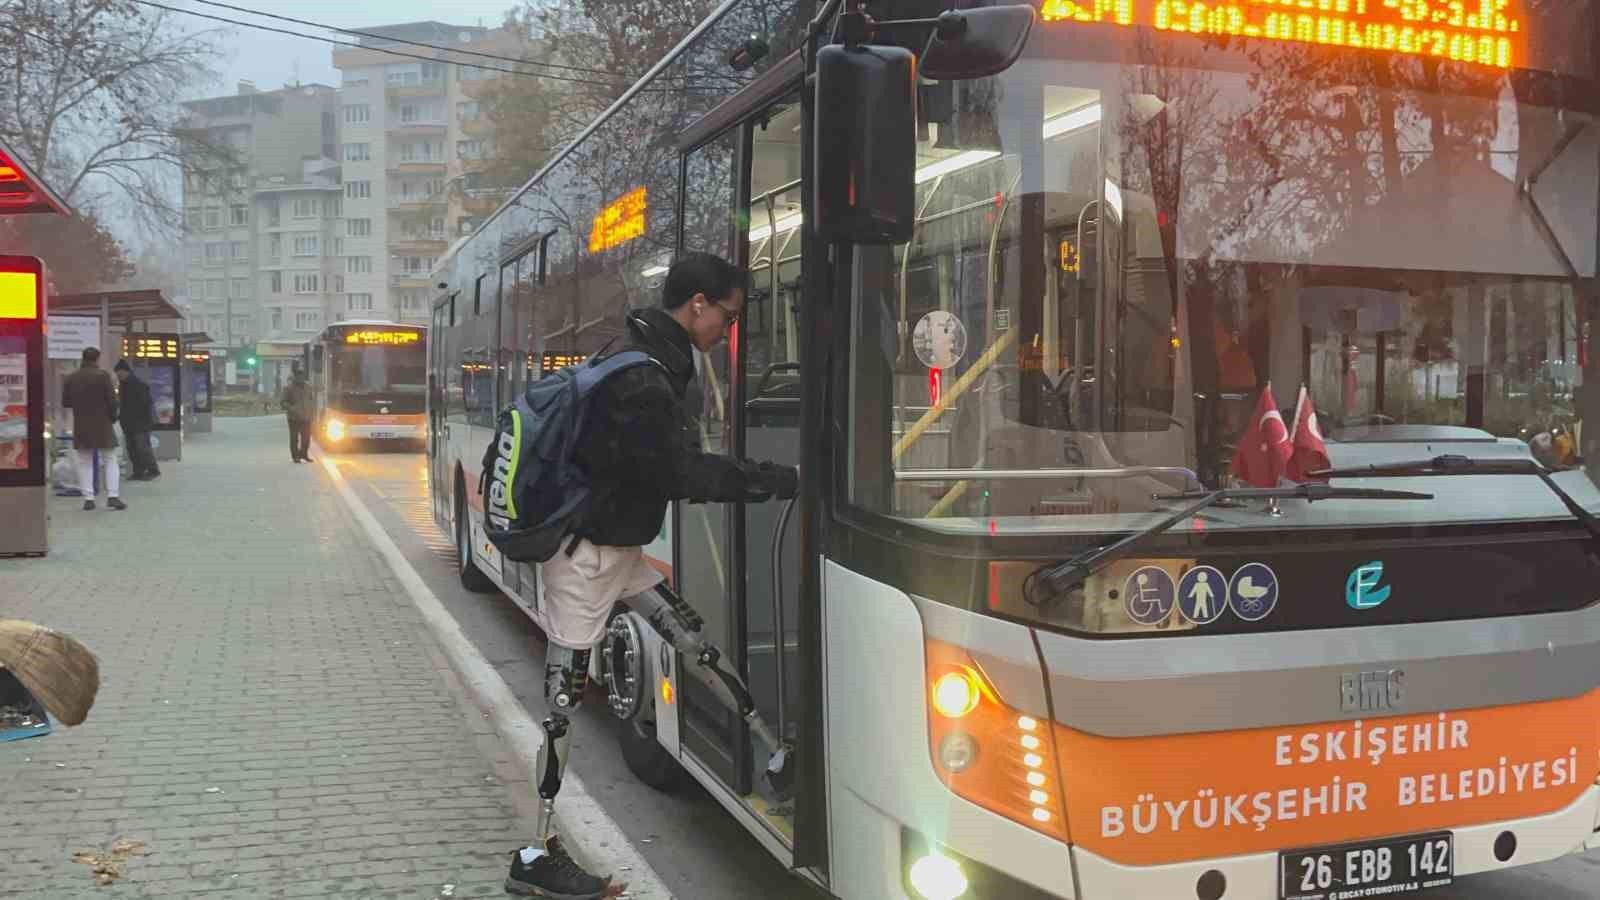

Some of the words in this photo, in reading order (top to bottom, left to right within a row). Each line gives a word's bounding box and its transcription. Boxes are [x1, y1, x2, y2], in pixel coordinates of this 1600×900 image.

[1336, 669, 1406, 712] BMC
[1276, 713, 1470, 766] ESKİŞEHİR
[1101, 775, 1368, 838] BÜYÜKŞEHİR
[1398, 746, 1578, 806] BELEDİYESİ
[1300, 854, 1332, 891] 26
[1345, 847, 1392, 885] EBB
[1407, 840, 1449, 877] 142
